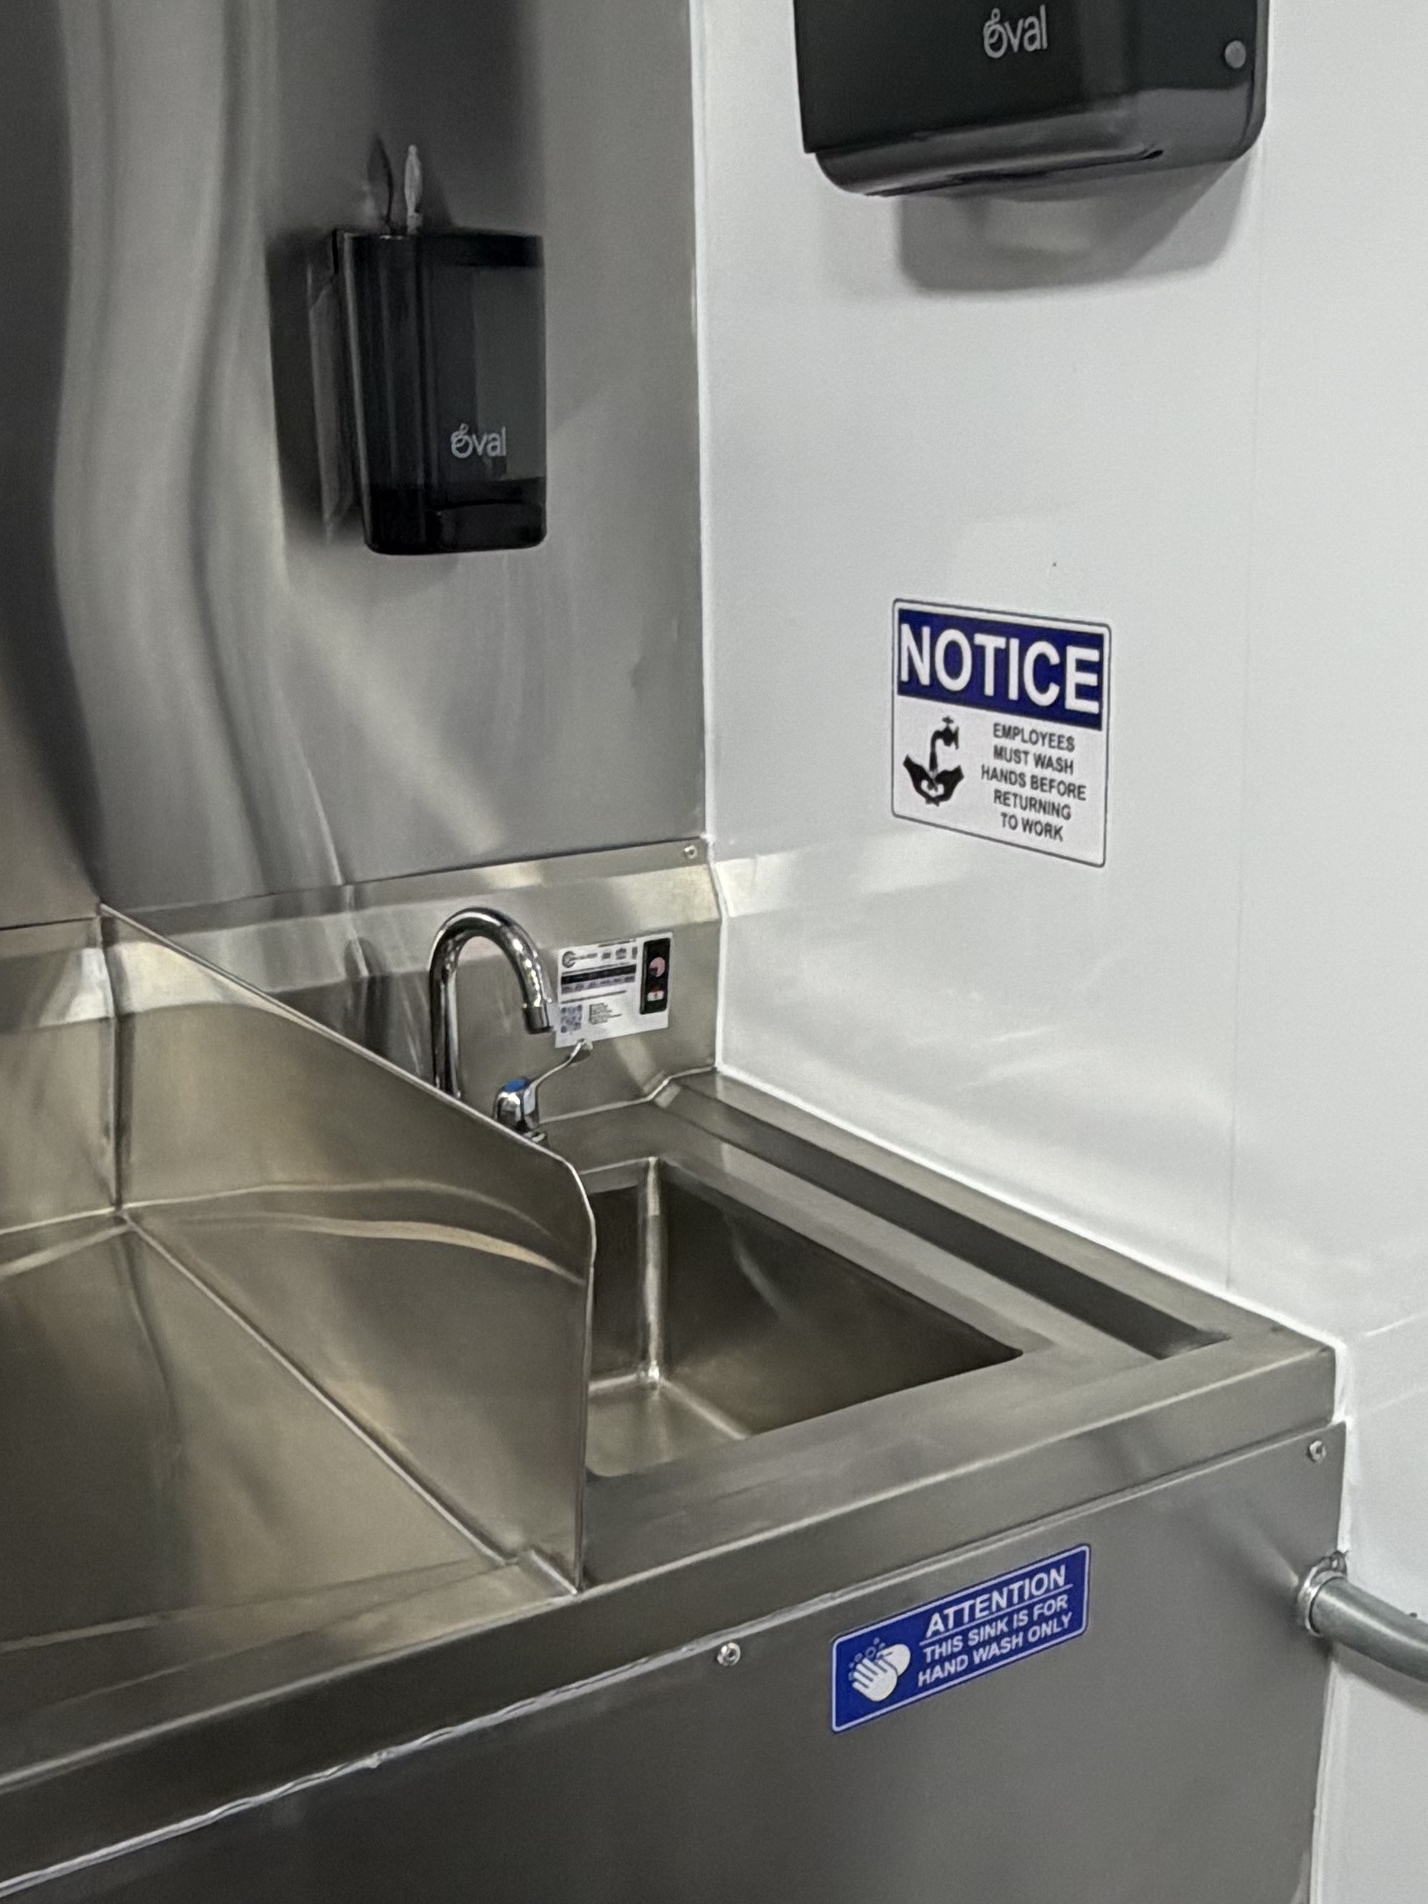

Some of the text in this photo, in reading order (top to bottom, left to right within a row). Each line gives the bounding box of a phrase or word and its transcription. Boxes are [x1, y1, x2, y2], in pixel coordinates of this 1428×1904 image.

[900, 623, 1100, 714] NOTICE
[993, 723, 1075, 752] EMPLOYEES
[993, 745, 1074, 775] MUST WASH
[981, 765, 1087, 801] HANDS BEFORE
[993, 789, 1072, 820] RETURNING
[1001, 812, 1064, 842] TO WORK
[926, 1564, 1066, 1638] ATTENTION
[923, 1594, 1068, 1664] THIS SINK IS FOR
[918, 1612, 1072, 1687] HAND WASH ONLY
